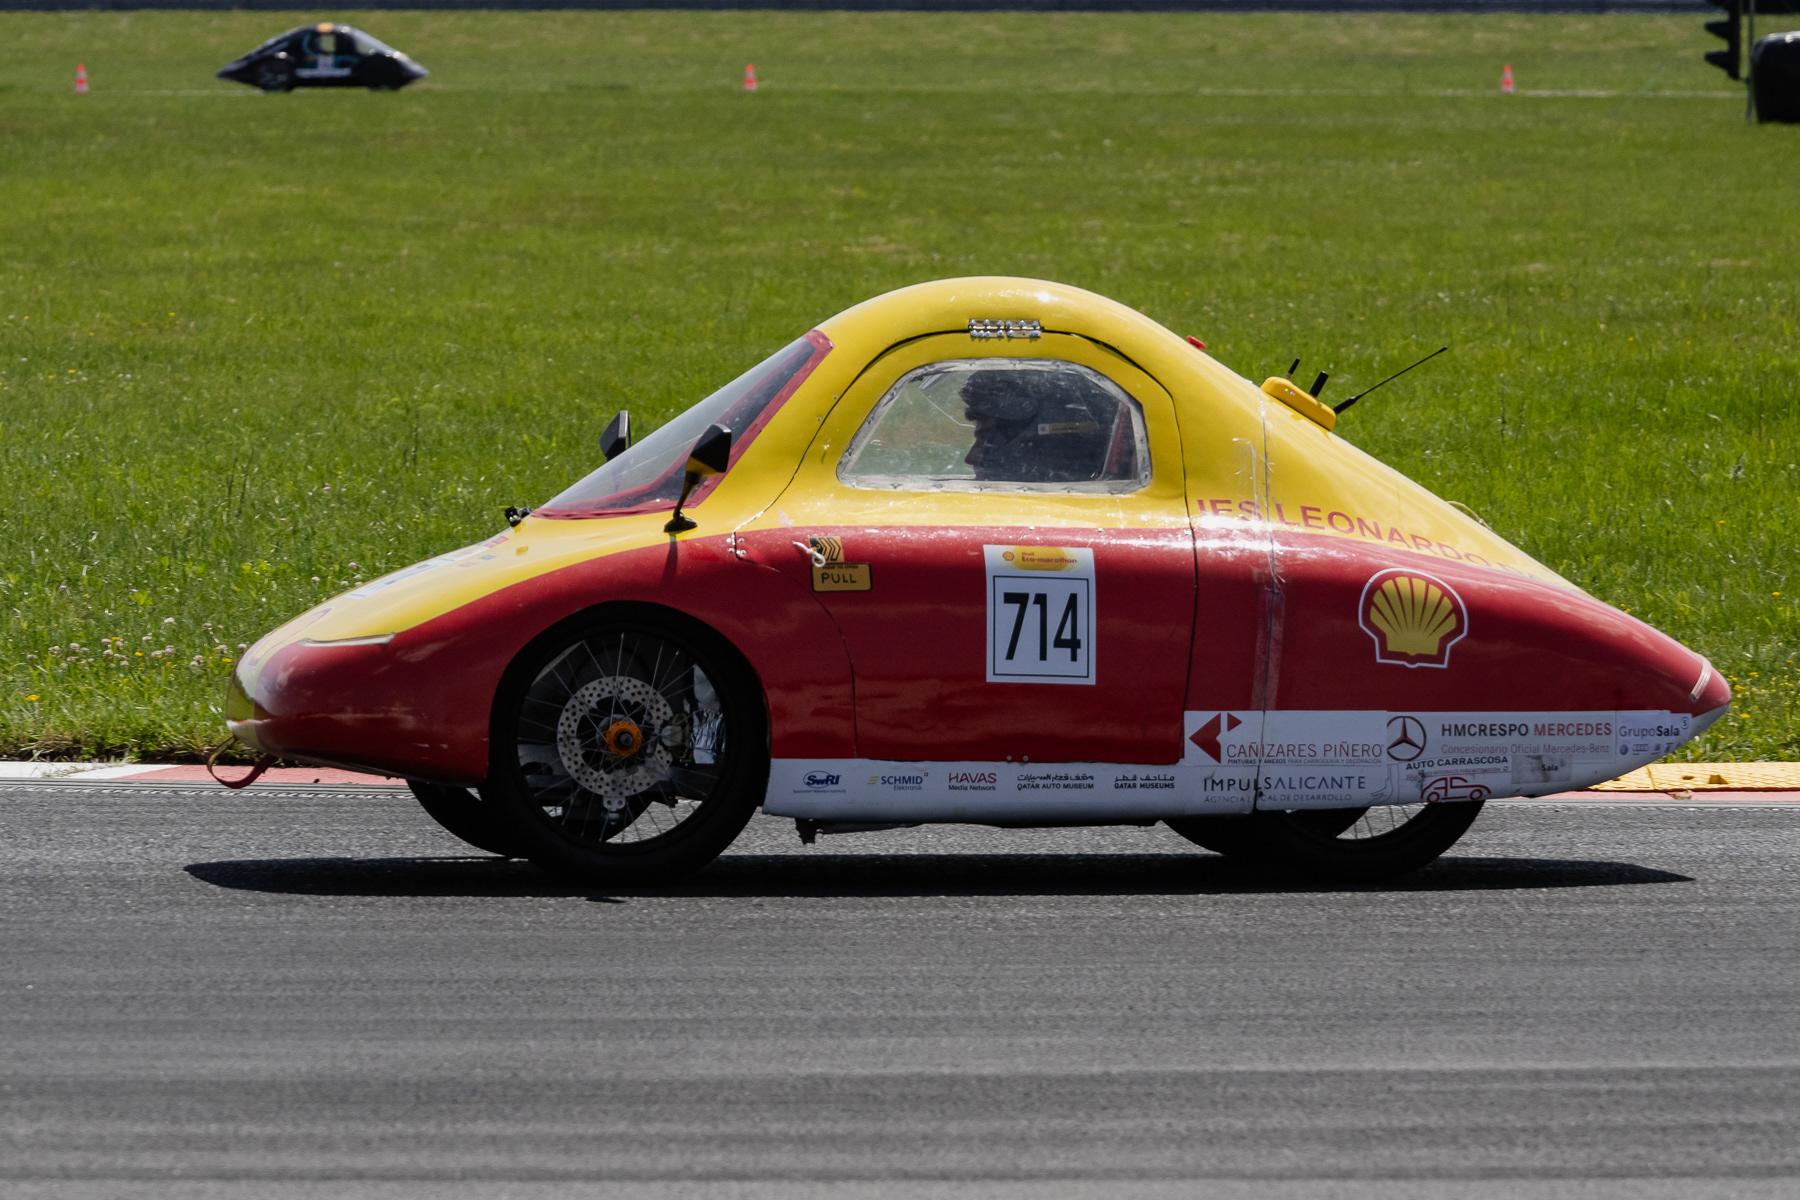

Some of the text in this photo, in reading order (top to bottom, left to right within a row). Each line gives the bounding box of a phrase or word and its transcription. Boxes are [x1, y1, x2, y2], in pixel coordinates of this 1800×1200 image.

[1275, 502, 1493, 568] LEONARDO
[1021, 556, 1077, 564] Eco-marathon
[821, 572, 857, 584] PULL
[1003, 591, 1081, 662] 714
[1441, 722, 1612, 736] HMCRESPO MERCEDES
[1618, 725, 1680, 739] GrupoSala
[1226, 740, 1382, 758] CAÑIZARES PIÑERO
[1441, 743, 1610, 754] Concesionario Oficial Mercedes-Benz
[1406, 756, 1508, 770] AUTO CARRASCOSA
[806, 775, 841, 786] SwRI
[880, 776, 923, 785] SCHMID
[948, 772, 997, 784] HAVAS
[1017, 783, 1040, 791] QATAR
[1247, 795, 1277, 803] LCAL
[1293, 793, 1352, 801] DESARROLLO
